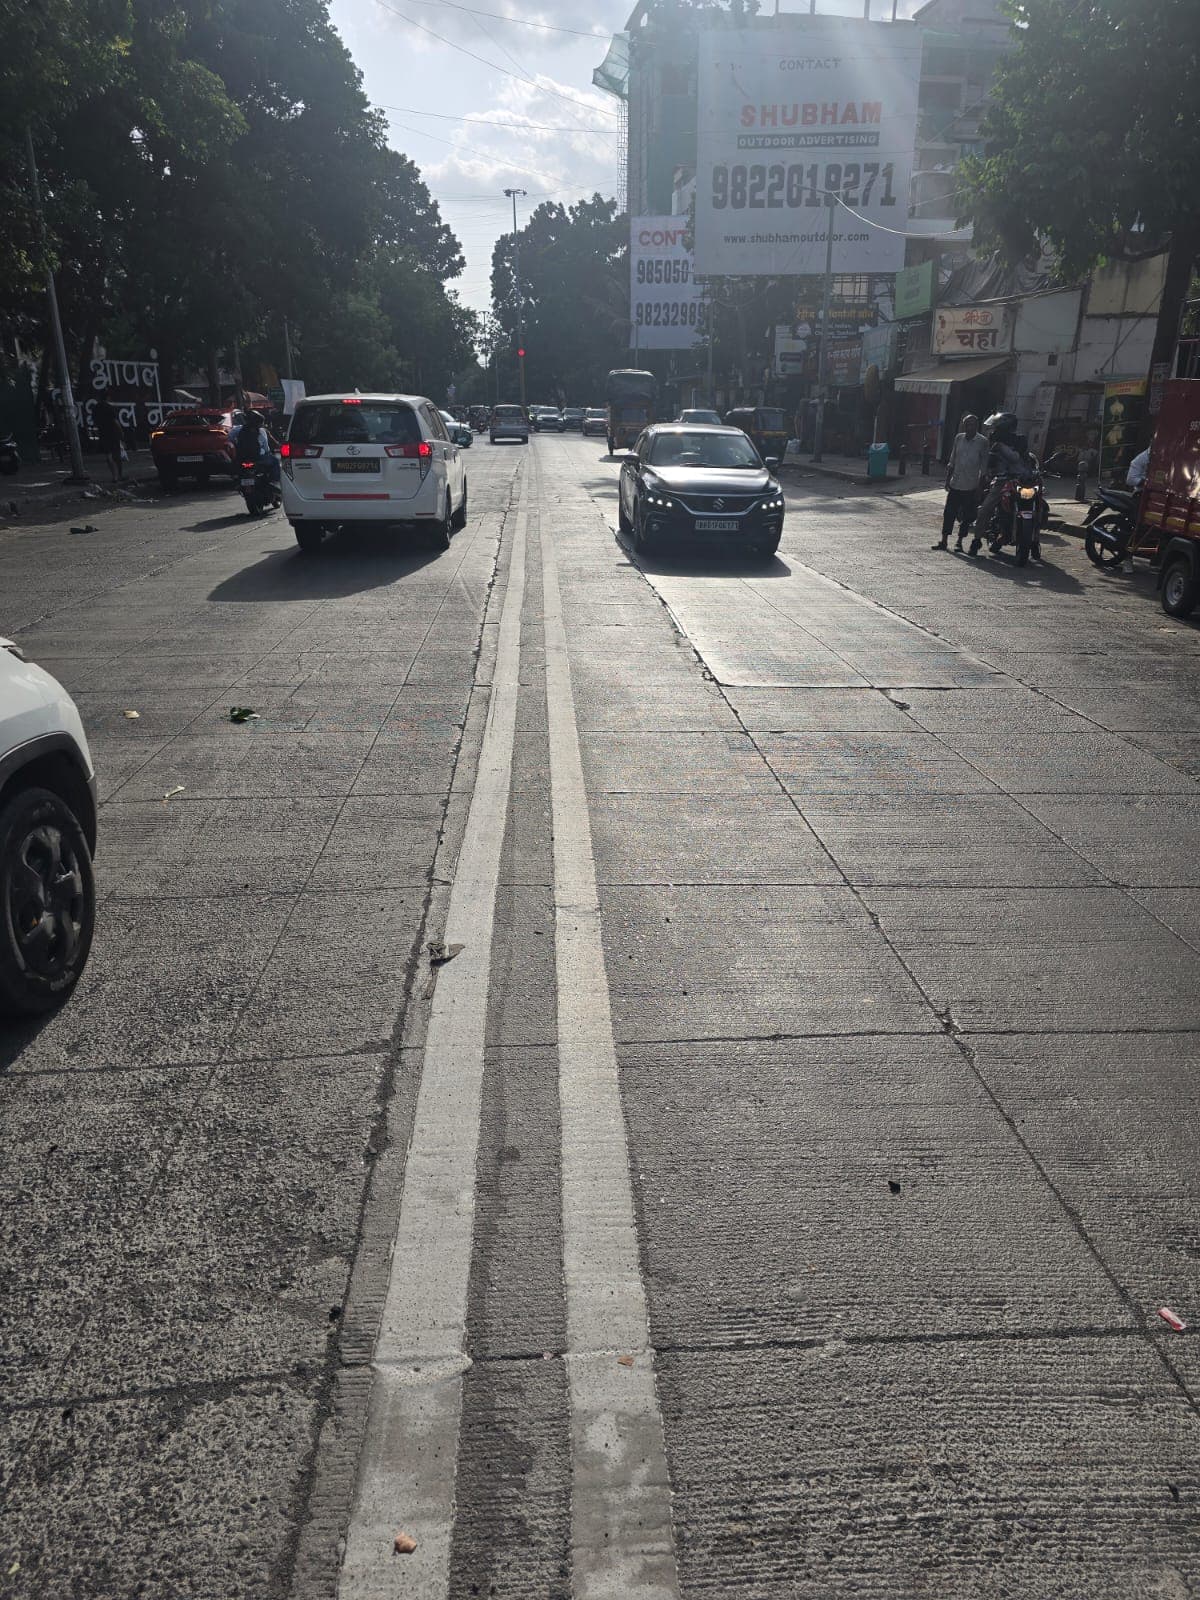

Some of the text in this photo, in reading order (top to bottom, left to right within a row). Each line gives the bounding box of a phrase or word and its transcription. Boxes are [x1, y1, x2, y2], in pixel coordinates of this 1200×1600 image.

[778, 57, 841, 72] CONTACT
[740, 102, 882, 127] SHUBHAM
[738, 134, 877, 147] OUTDOOR ADVERTISING
[712, 163, 897, 209] 9822019271
[955, 329, 999, 351] चहा
